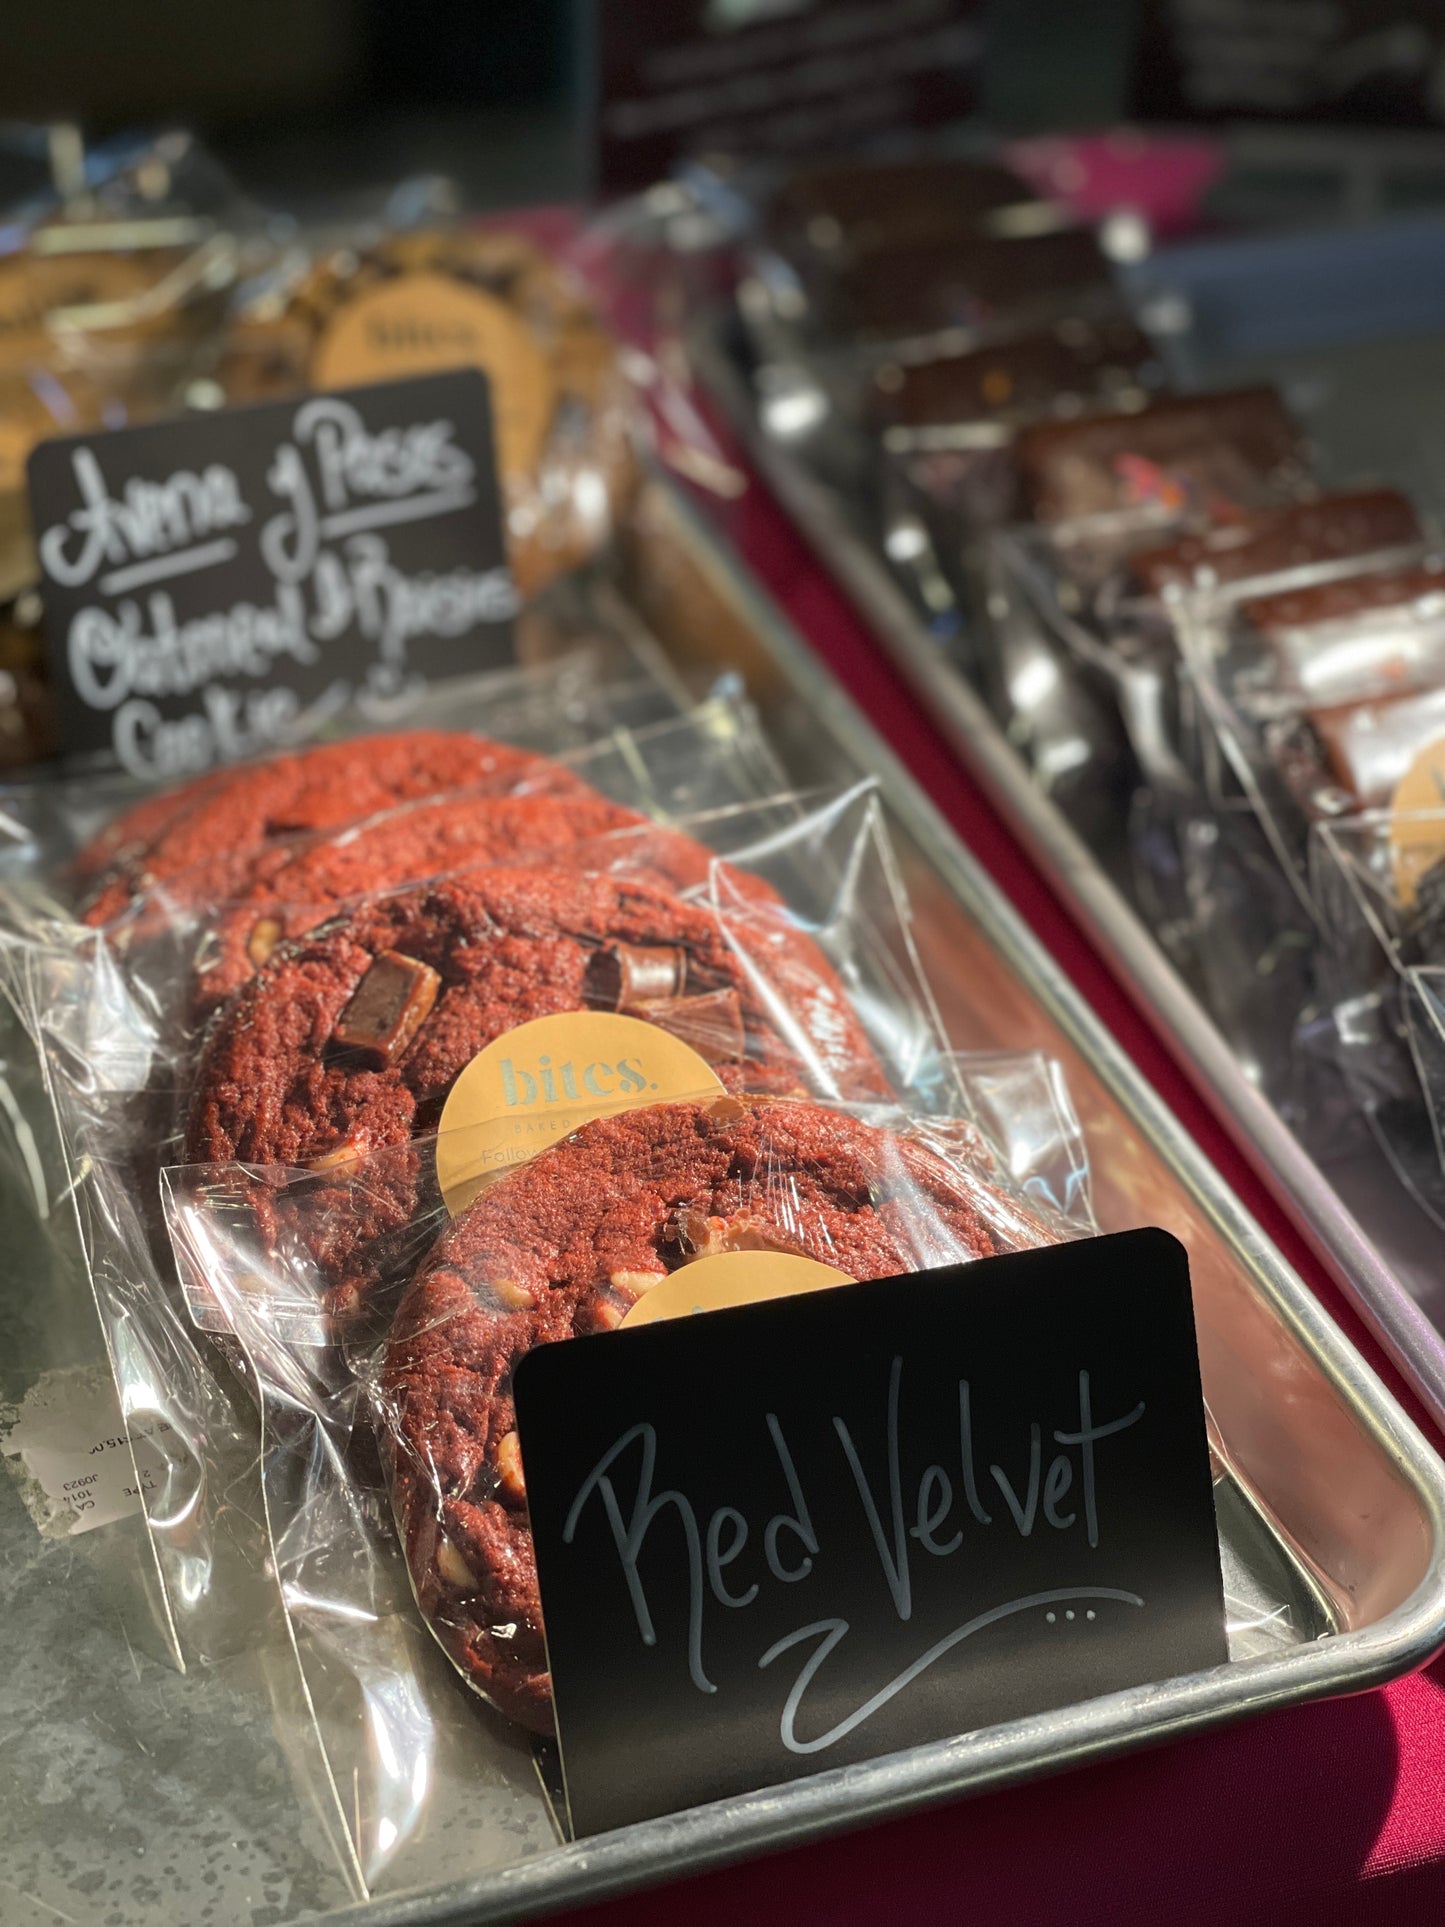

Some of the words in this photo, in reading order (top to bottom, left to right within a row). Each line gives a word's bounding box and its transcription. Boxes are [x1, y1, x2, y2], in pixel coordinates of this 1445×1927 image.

[514, 1119, 570, 1134] BAKED
[63, 1473, 99, 1491] J0923
[75, 1500, 95, 1511] CA
[562, 1412, 820, 1694] Red
[832, 1355, 1147, 1621] Velvet
